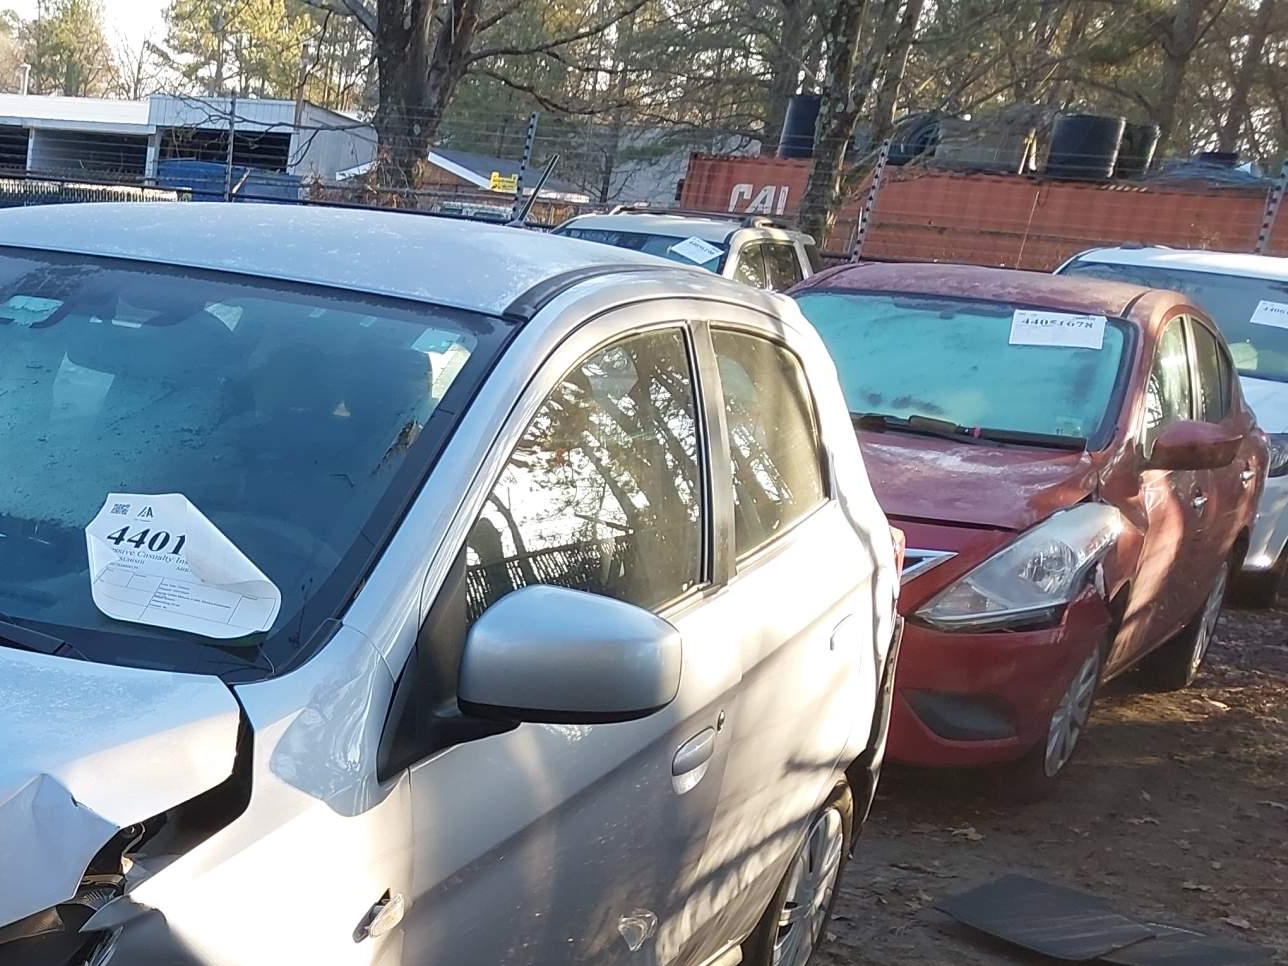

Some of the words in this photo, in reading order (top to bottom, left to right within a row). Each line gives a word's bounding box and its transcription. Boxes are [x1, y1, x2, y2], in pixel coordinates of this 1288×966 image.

[728, 183, 789, 216] CAI
[106, 525, 186, 556] 4401
[137, 550, 173, 564] Casualty
